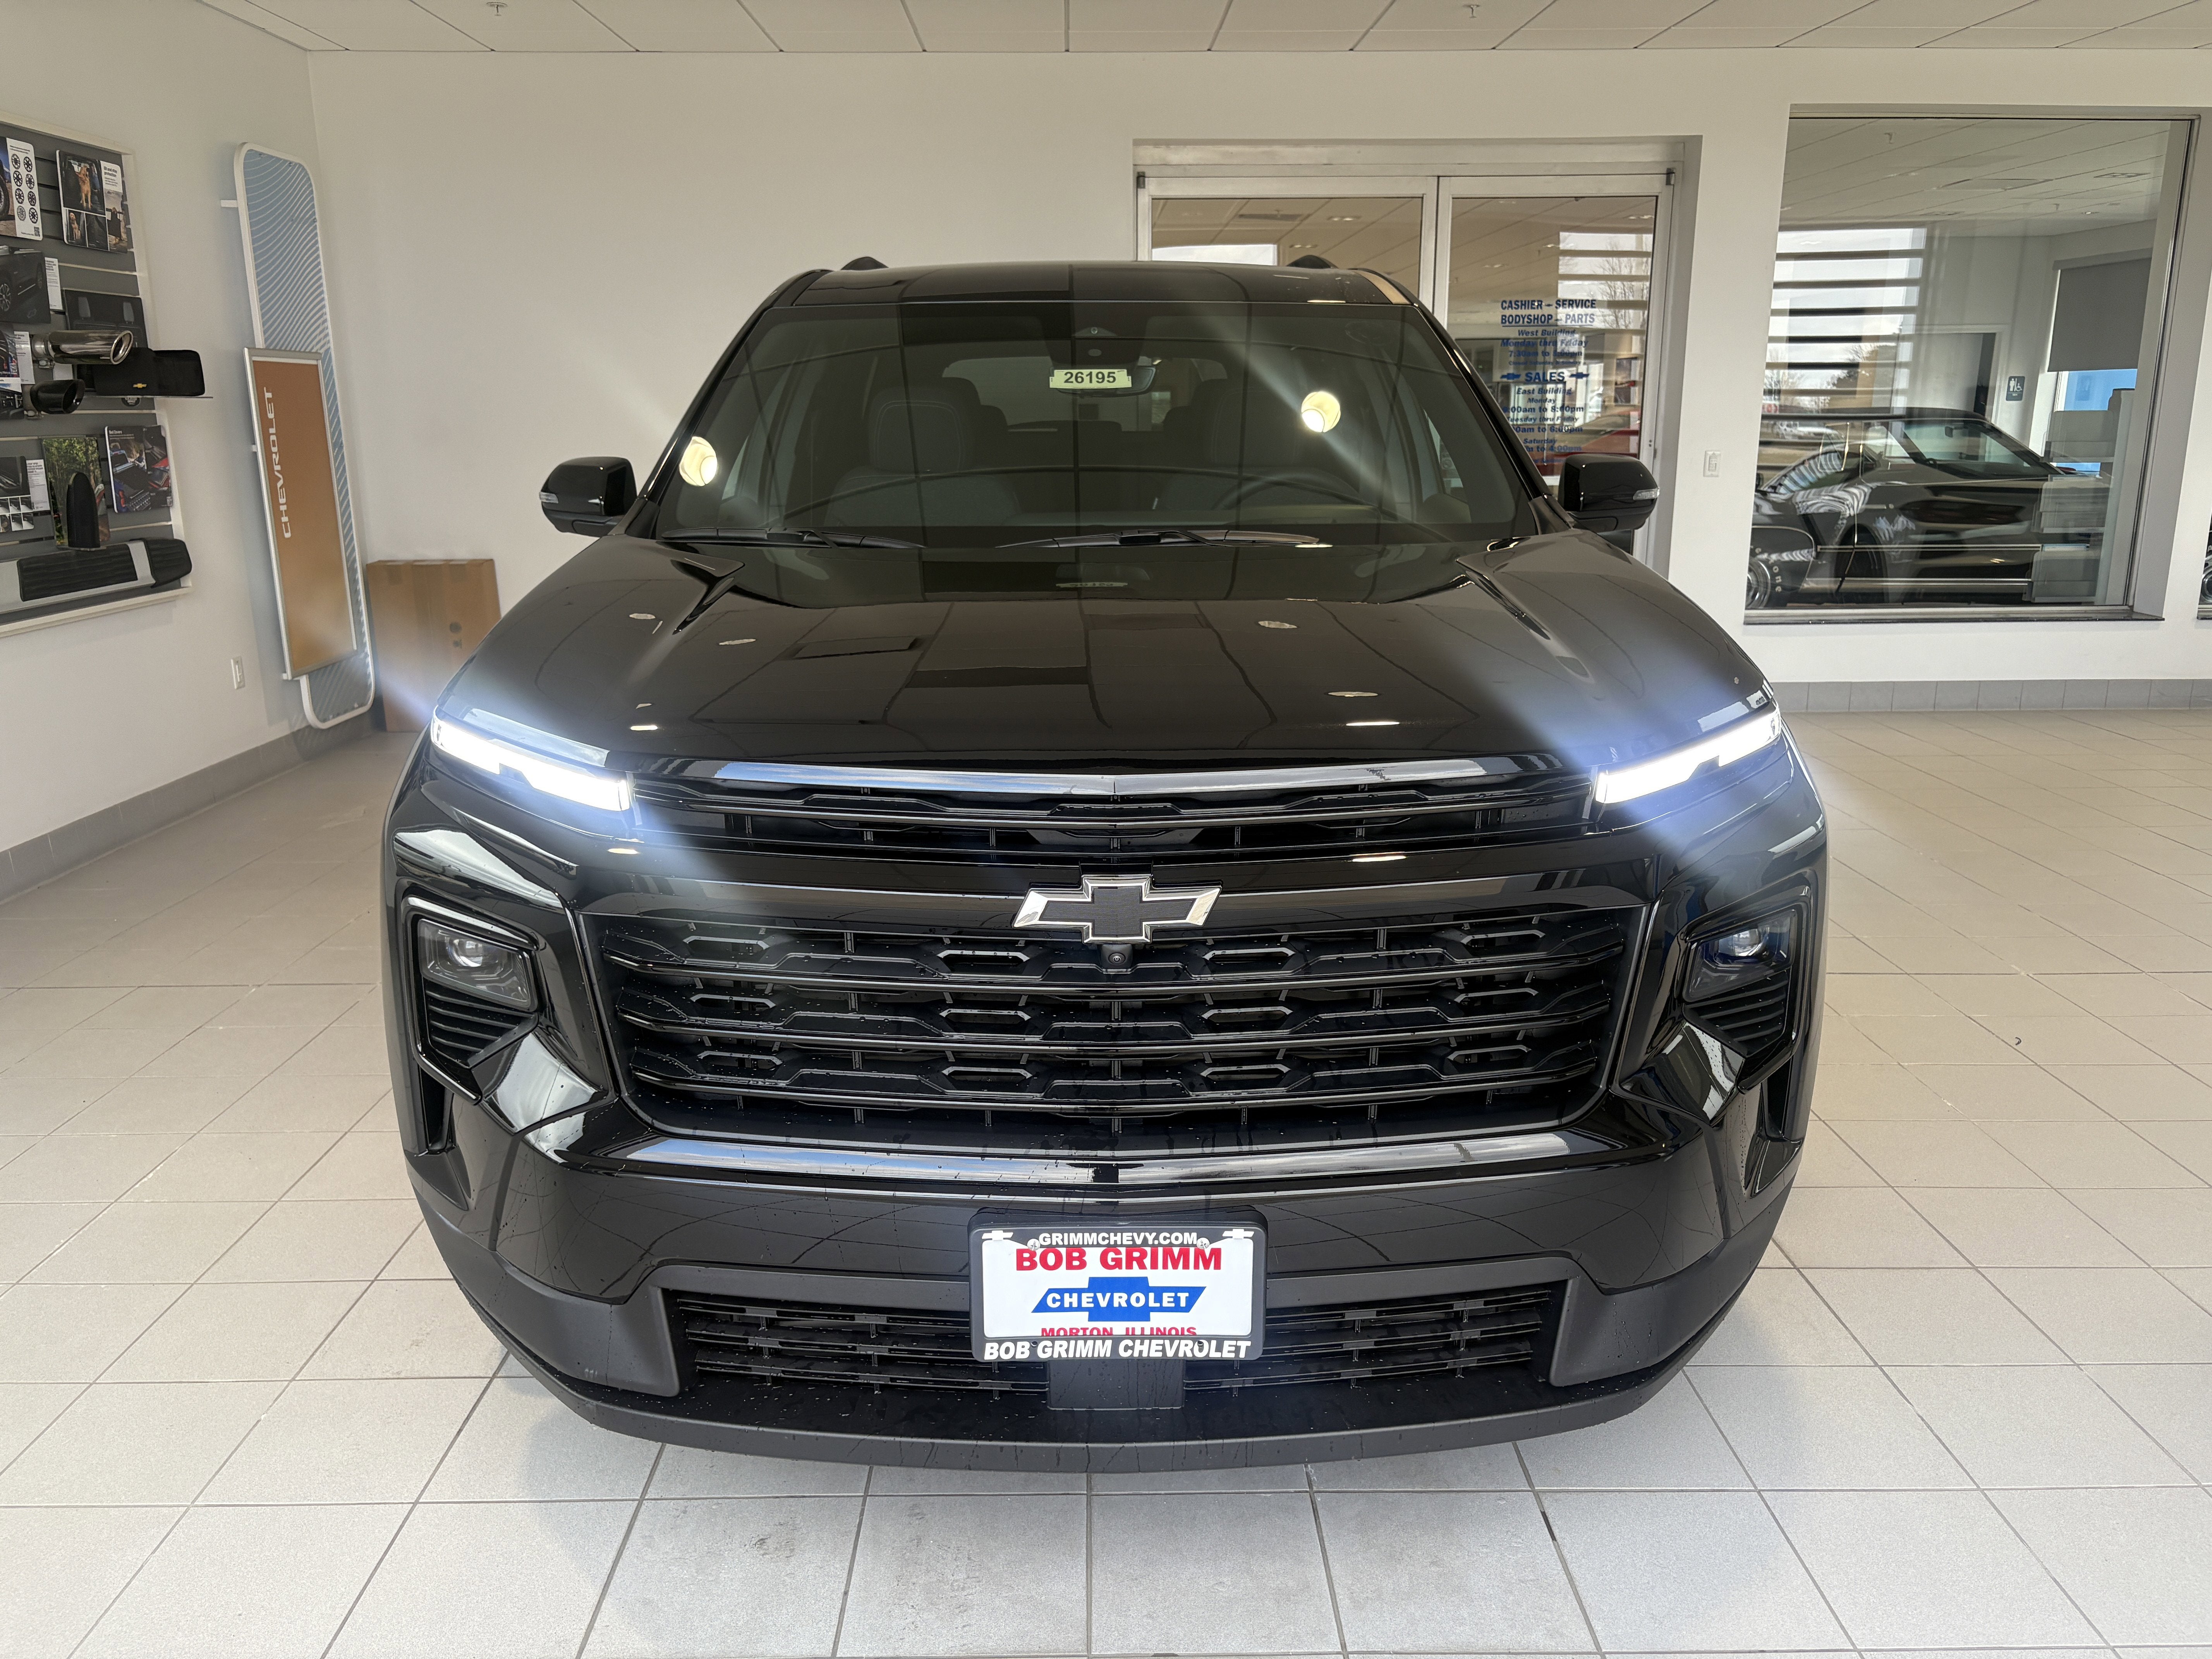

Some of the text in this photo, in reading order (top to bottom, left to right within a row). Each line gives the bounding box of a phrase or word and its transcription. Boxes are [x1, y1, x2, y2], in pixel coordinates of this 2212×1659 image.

[1501, 300, 1543, 310] CASHIER
[1555, 299, 1596, 309] SERVICE
[1501, 314, 1553, 325] BODYSHOP
[1565, 313, 1595, 324] PARTS
[1064, 371, 1116, 383] 26195
[1525, 372, 1565, 382] SALES
[1538, 387, 1571, 395] Building
[264, 387, 291, 538] CHEVROLET
[1039, 1231, 1197, 1246] GRIMMCHEVY.COM
[1016, 1247, 1221, 1271] BOB GRIMM
[1046, 1292, 1189, 1308] CHEVROLET
[984, 1340, 1251, 1360] BOB GRIMM CHEVROLET
